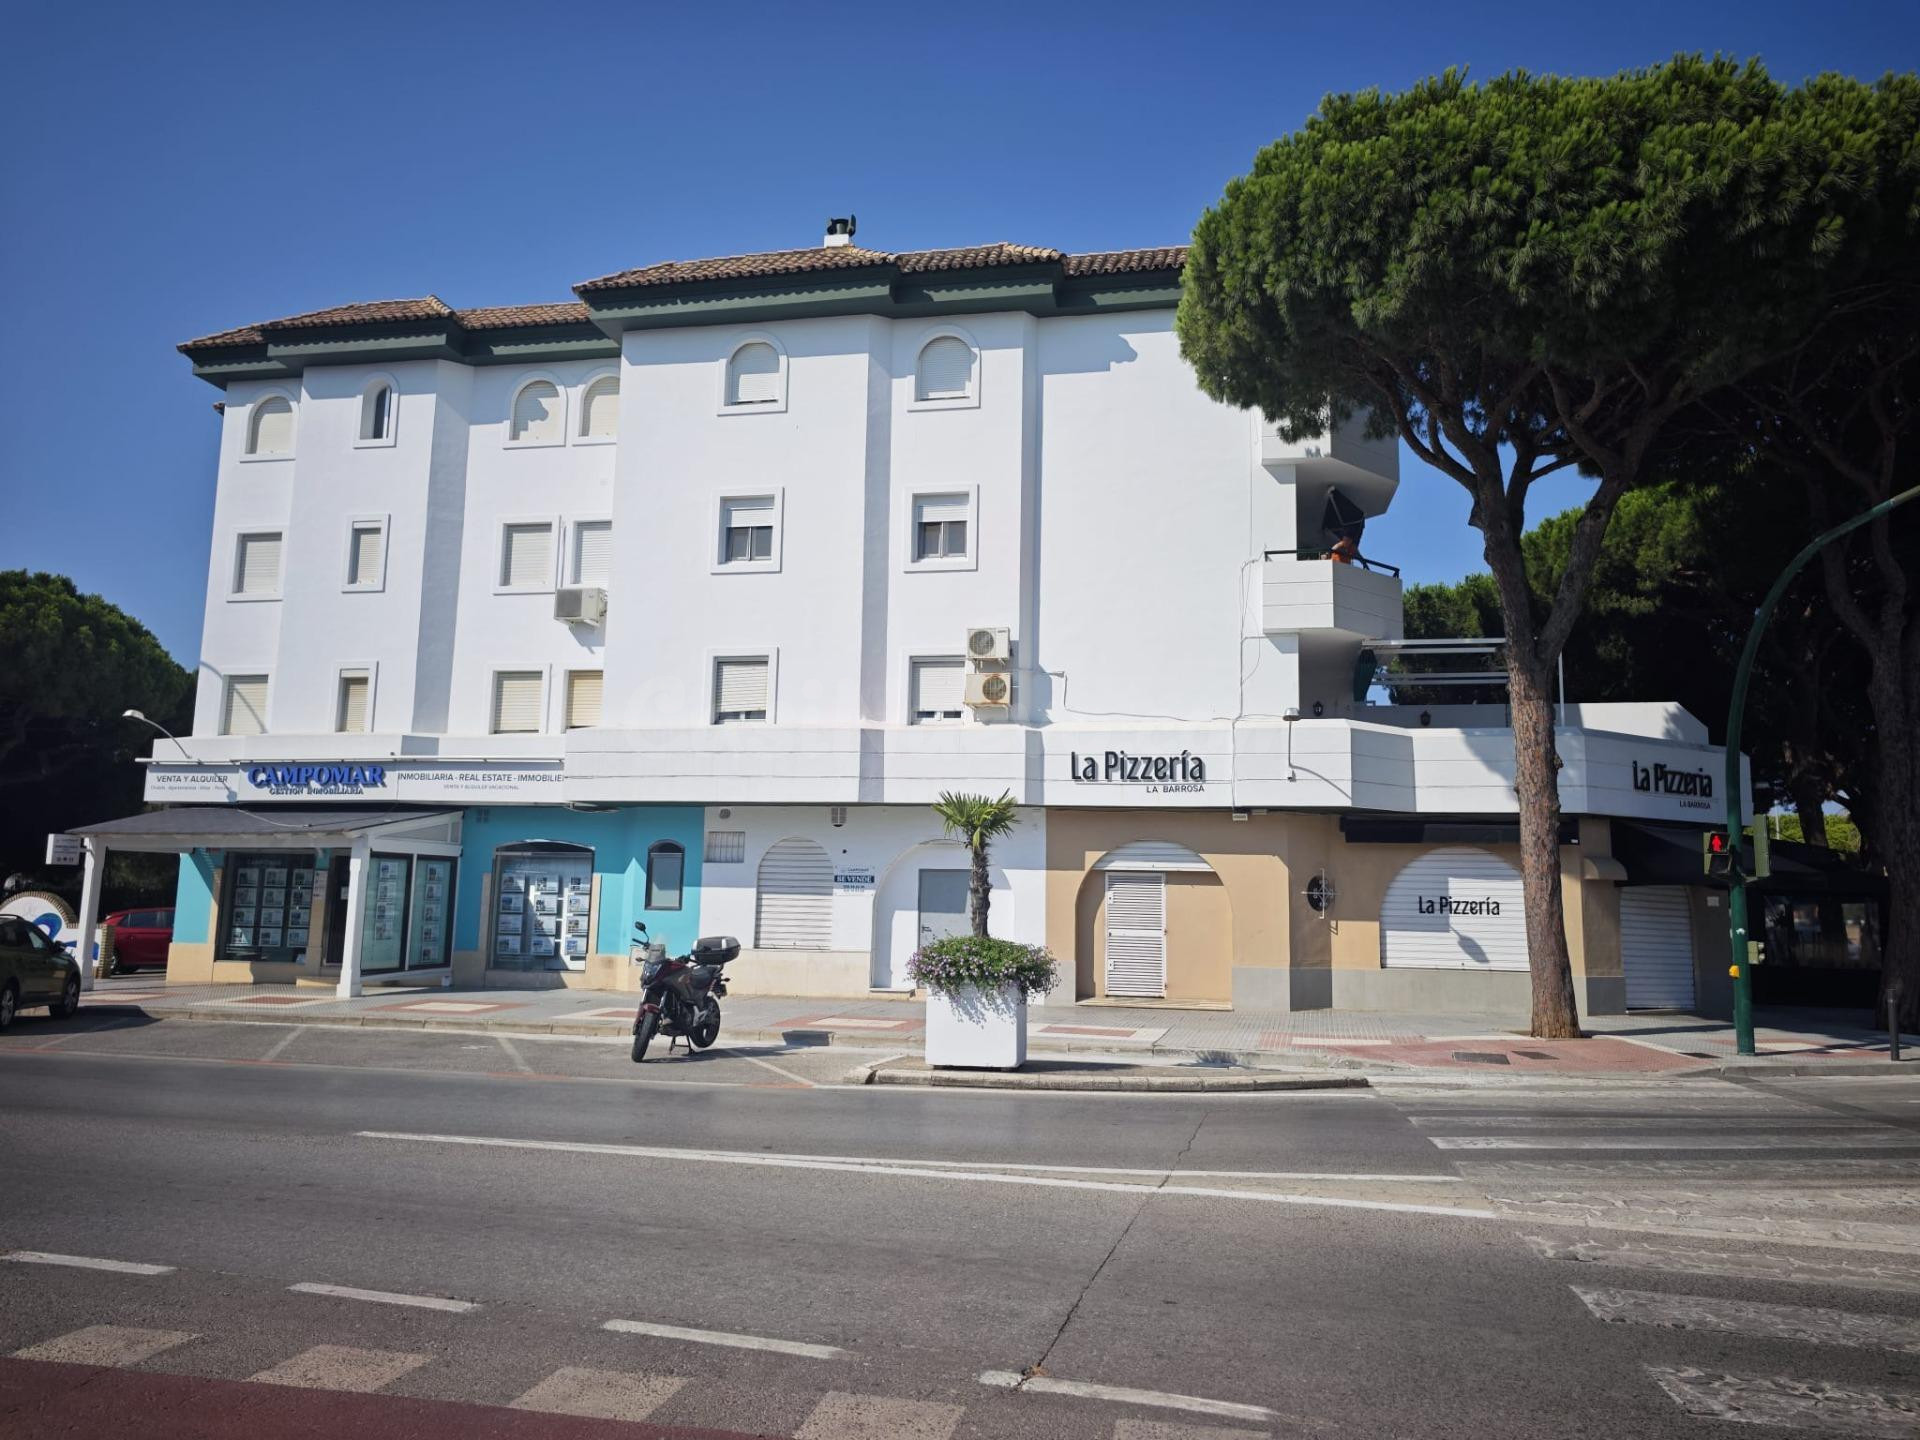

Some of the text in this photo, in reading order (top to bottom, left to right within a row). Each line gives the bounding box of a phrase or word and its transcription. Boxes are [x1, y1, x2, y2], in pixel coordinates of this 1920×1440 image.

[1071, 750, 1204, 781] La Pizzería
[156, 775, 228, 783] VENTA Y ALQUILER
[248, 765, 386, 788] CAMPOMAR
[397, 772, 454, 782] INMOBILIARIA
[459, 773, 480, 782] REAL
[482, 774, 512, 782] ESTATE
[1632, 760, 1651, 792] La
[307, 786, 364, 795] INMOBILIARIA
[1162, 784, 1205, 793] BARROSA
[1418, 895, 1500, 916] La Pizzería
